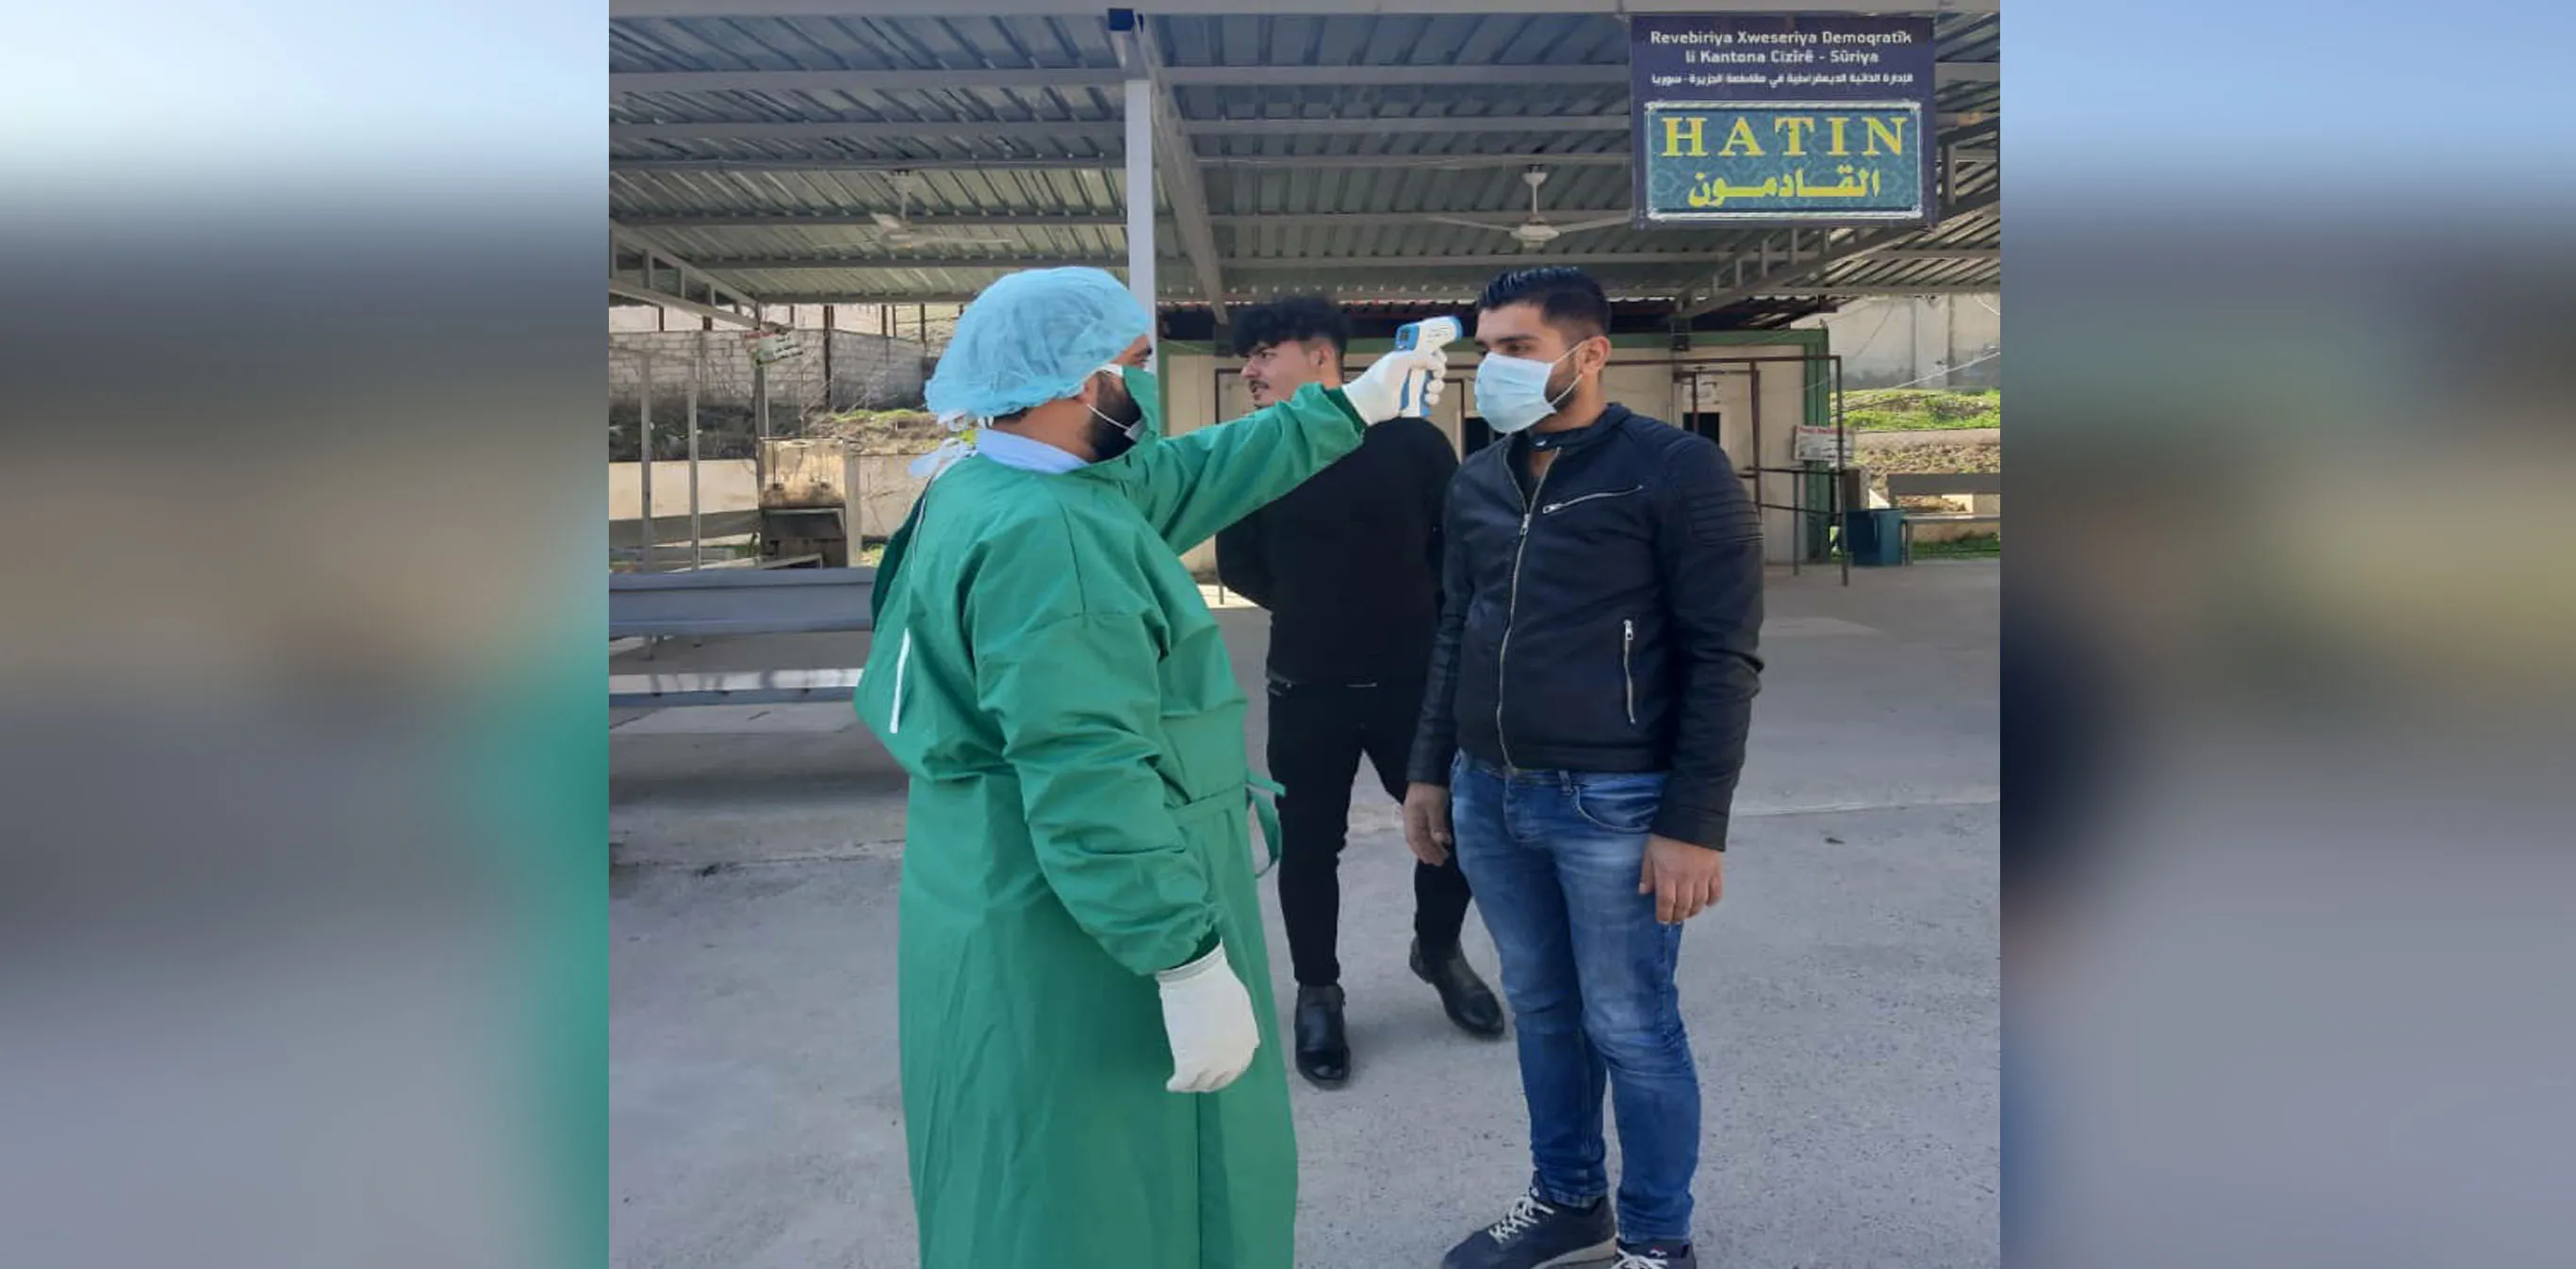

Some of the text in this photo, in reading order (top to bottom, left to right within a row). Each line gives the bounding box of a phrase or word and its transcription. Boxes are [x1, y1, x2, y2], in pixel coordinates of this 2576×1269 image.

[1650, 31, 1732, 46] Revebiriya
[1737, 30, 1817, 46] Xweseriya
[1685, 50, 1696, 63] li
[1700, 50, 1765, 63] Kantona
[1829, 49, 1879, 66] Sûriya
[1651, 73, 1682, 87] سوريا
[1769, 74, 1784, 88] في
[1661, 116, 1908, 157] HATIN
[1687, 163, 1881, 208] القادمون
